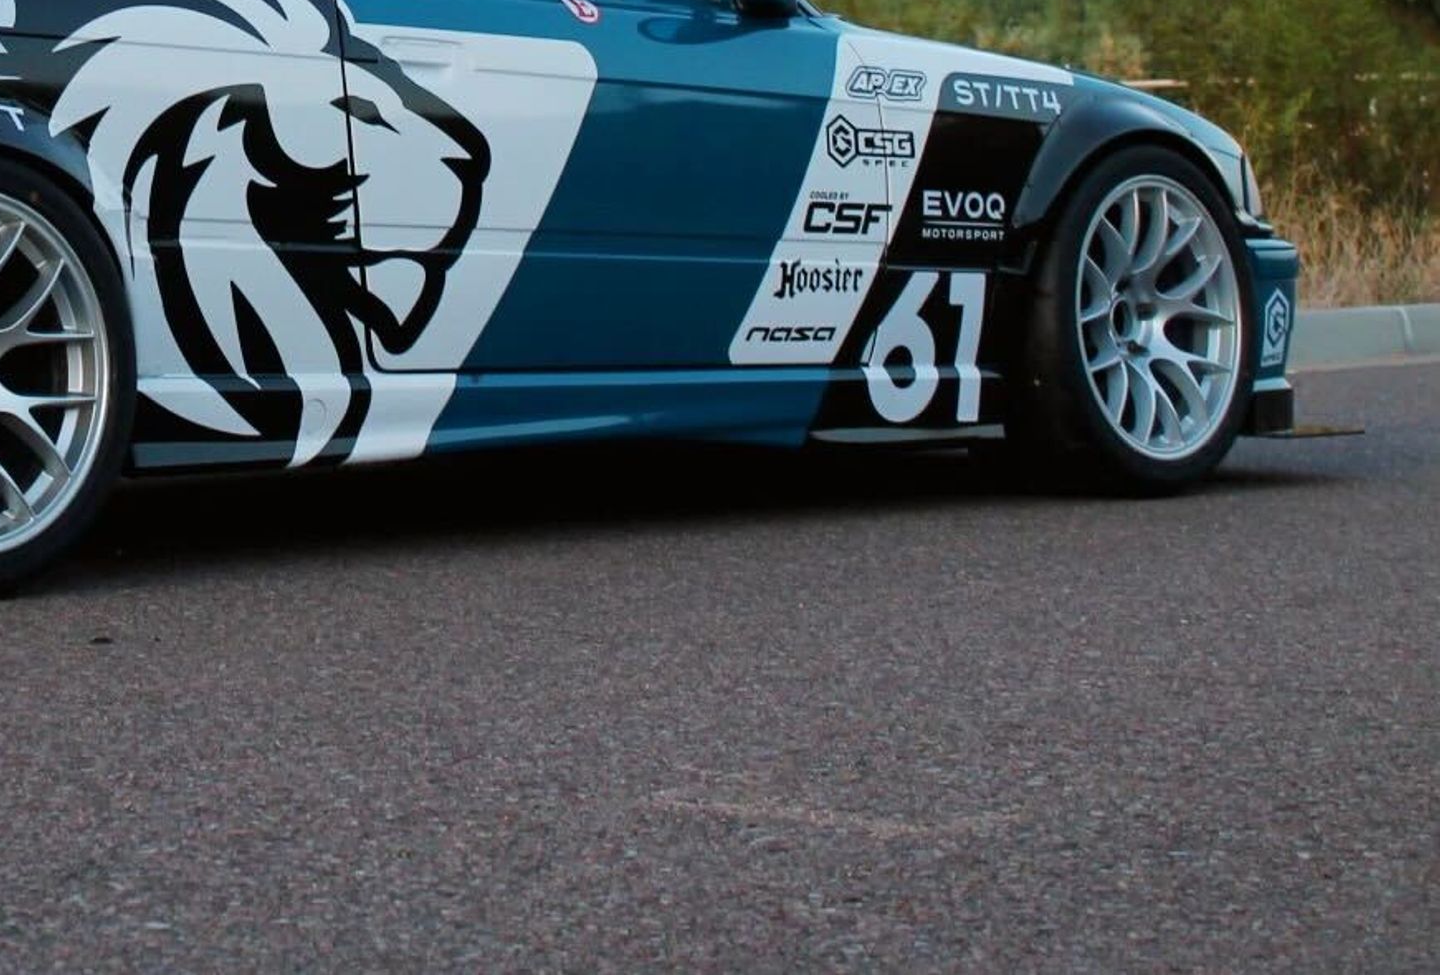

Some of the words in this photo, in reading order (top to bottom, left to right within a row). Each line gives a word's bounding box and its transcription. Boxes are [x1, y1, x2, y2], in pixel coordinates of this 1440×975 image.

[850, 71, 924, 97] APEX
[953, 79, 1062, 115] ST/TT4
[857, 131, 914, 155] CSG
[810, 191, 838, 200] COOLED
[922, 190, 1006, 220] EVOQ
[803, 202, 893, 235] CSF
[922, 227, 1005, 241] MOTORSPORT
[773, 257, 863, 299] Hoosier
[861, 271, 987, 423] 61
